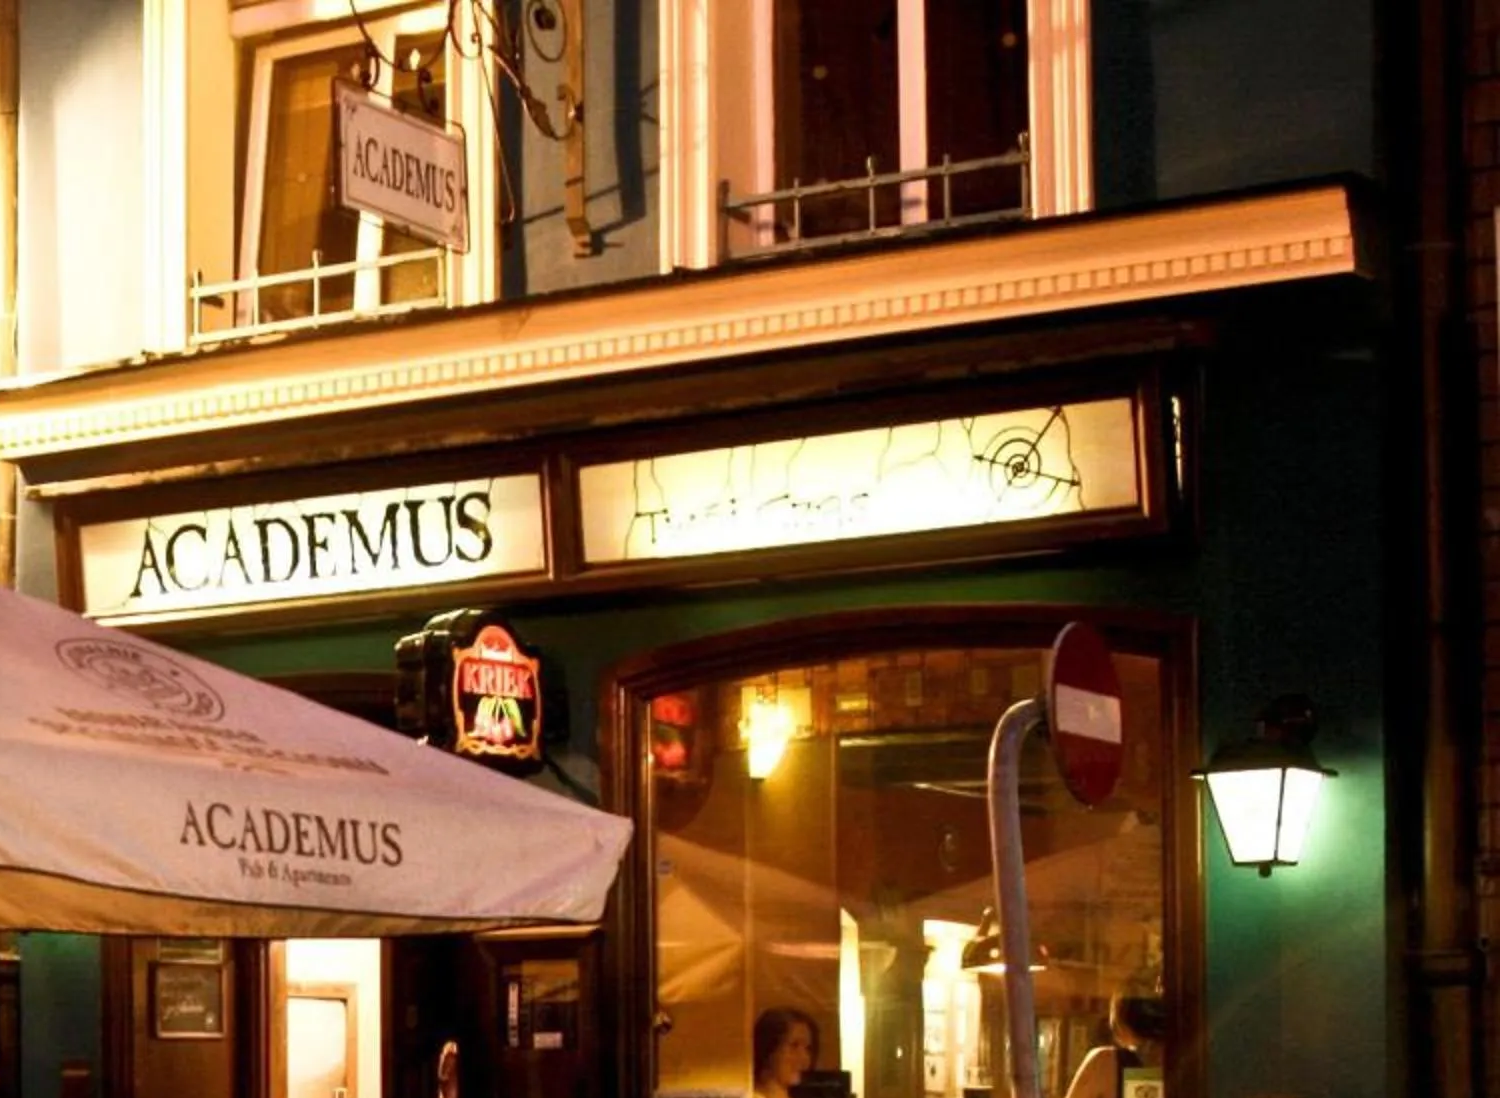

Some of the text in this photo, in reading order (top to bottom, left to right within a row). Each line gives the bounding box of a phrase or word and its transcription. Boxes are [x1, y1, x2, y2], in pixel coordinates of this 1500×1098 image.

[353, 134, 455, 212] ACADEMUS
[130, 491, 493, 598] ACADEMUS
[463, 661, 532, 699] KRIEK
[180, 801, 403, 867] ACADEMUS
